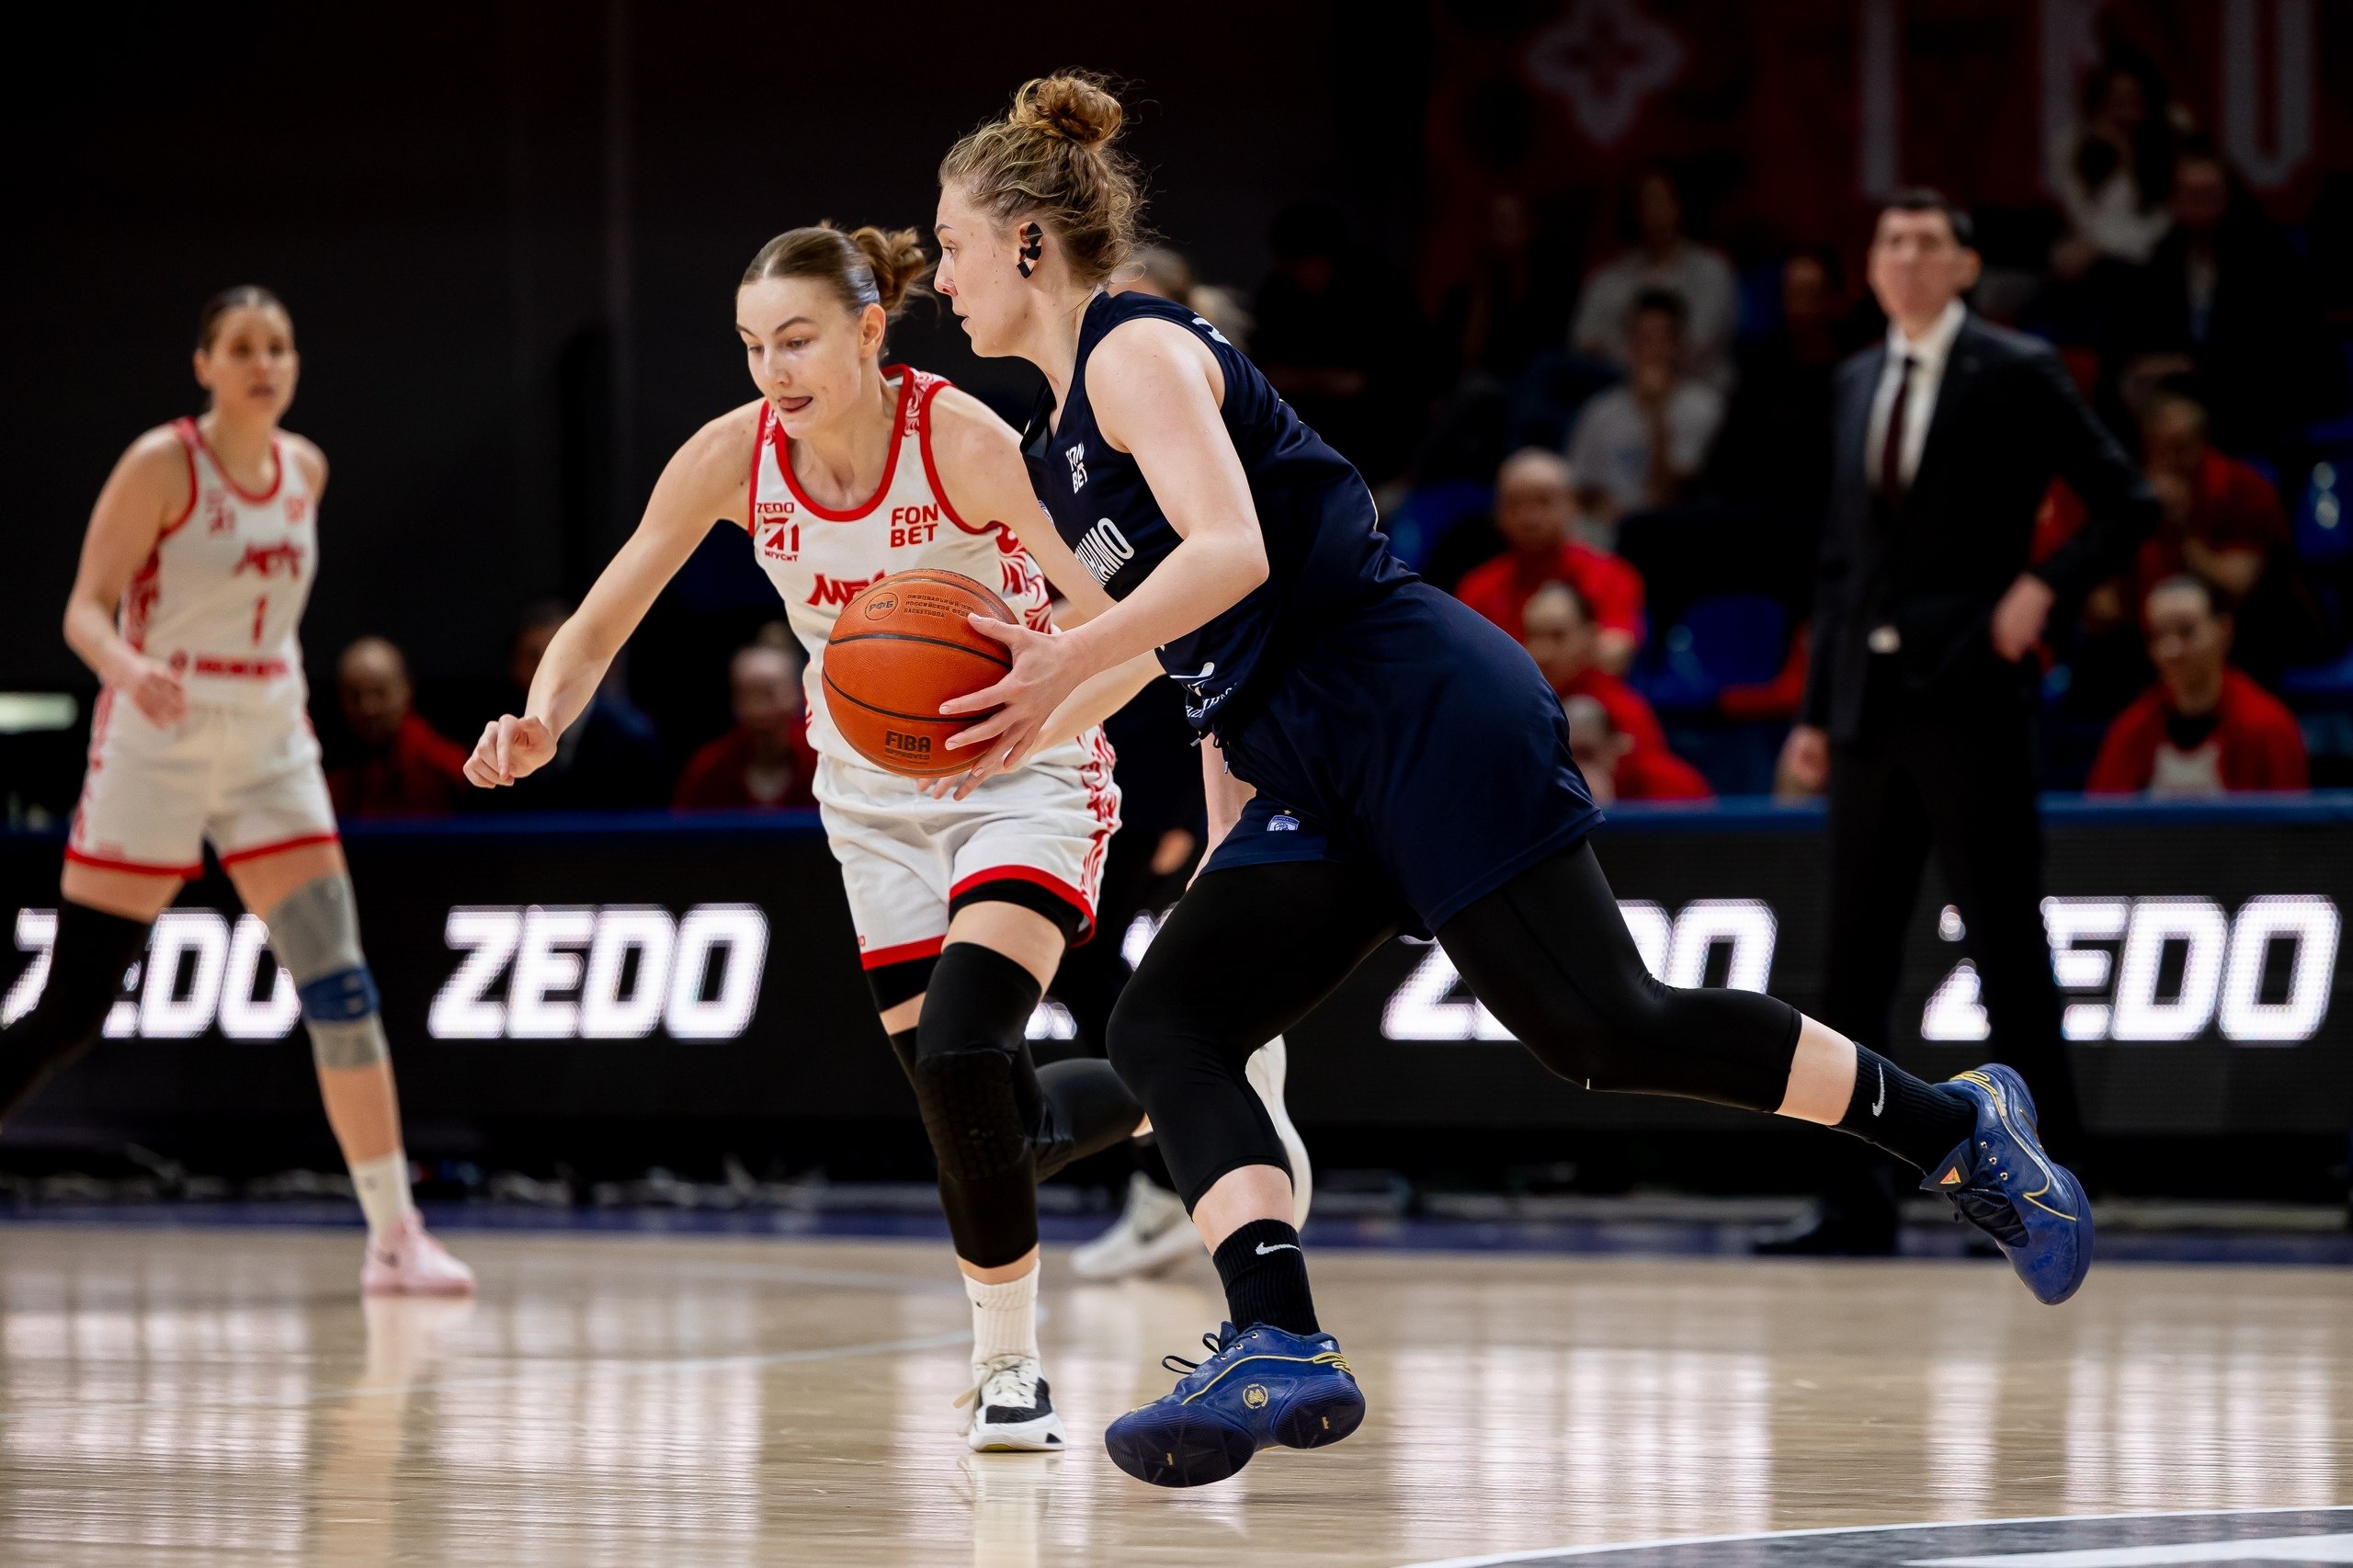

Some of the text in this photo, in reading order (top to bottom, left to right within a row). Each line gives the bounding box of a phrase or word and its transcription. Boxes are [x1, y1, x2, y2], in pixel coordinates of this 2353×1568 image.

[1072, 461, 1088, 494] BET
[891, 503, 938, 527] FON
[890, 523, 938, 548] BET
[869, 600, 894, 612] РФБ
[885, 730, 932, 753] FIBA
[428, 904, 768, 1039] ZEDO
